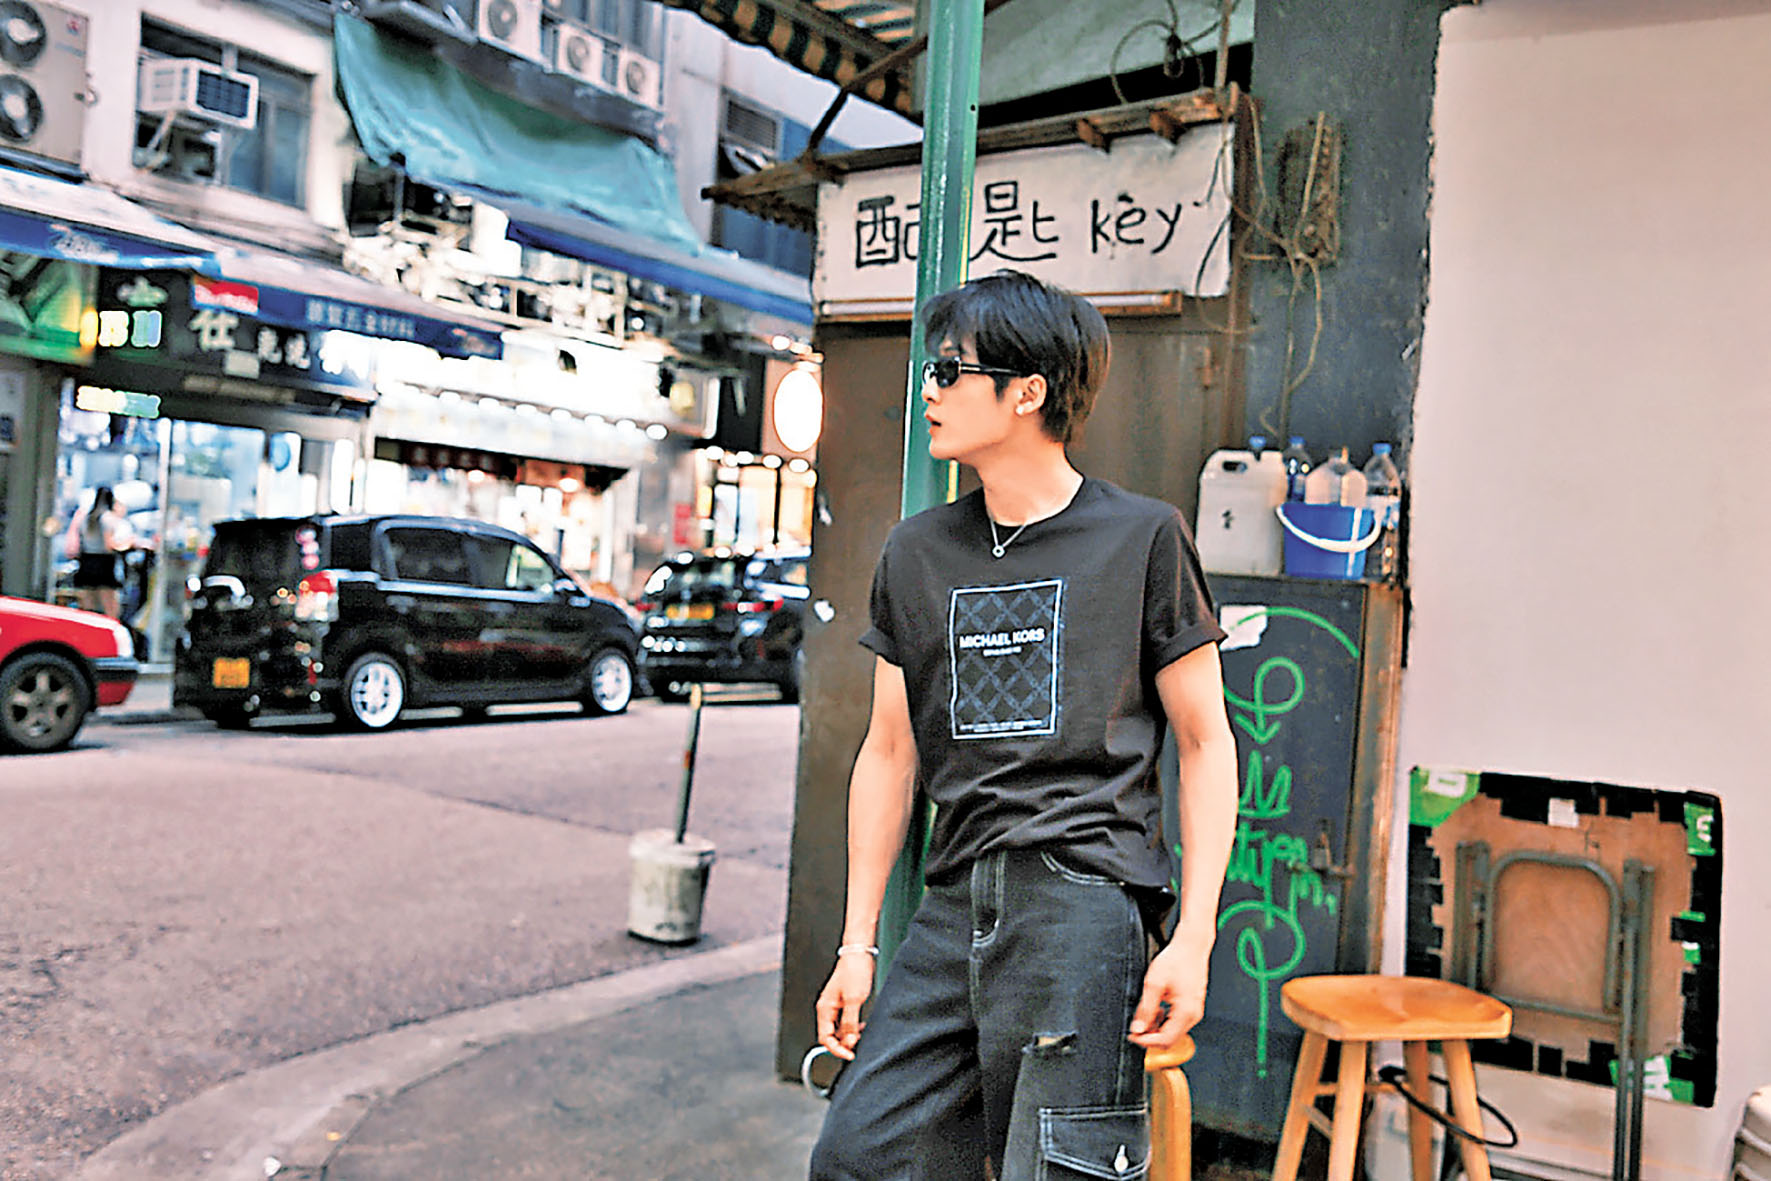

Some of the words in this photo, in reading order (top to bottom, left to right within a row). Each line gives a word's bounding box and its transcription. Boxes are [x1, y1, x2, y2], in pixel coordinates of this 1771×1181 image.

[1091, 194, 1182, 254] key
[959, 632, 1012, 649] MICHAEL
[1012, 627, 1046, 645] KORS
